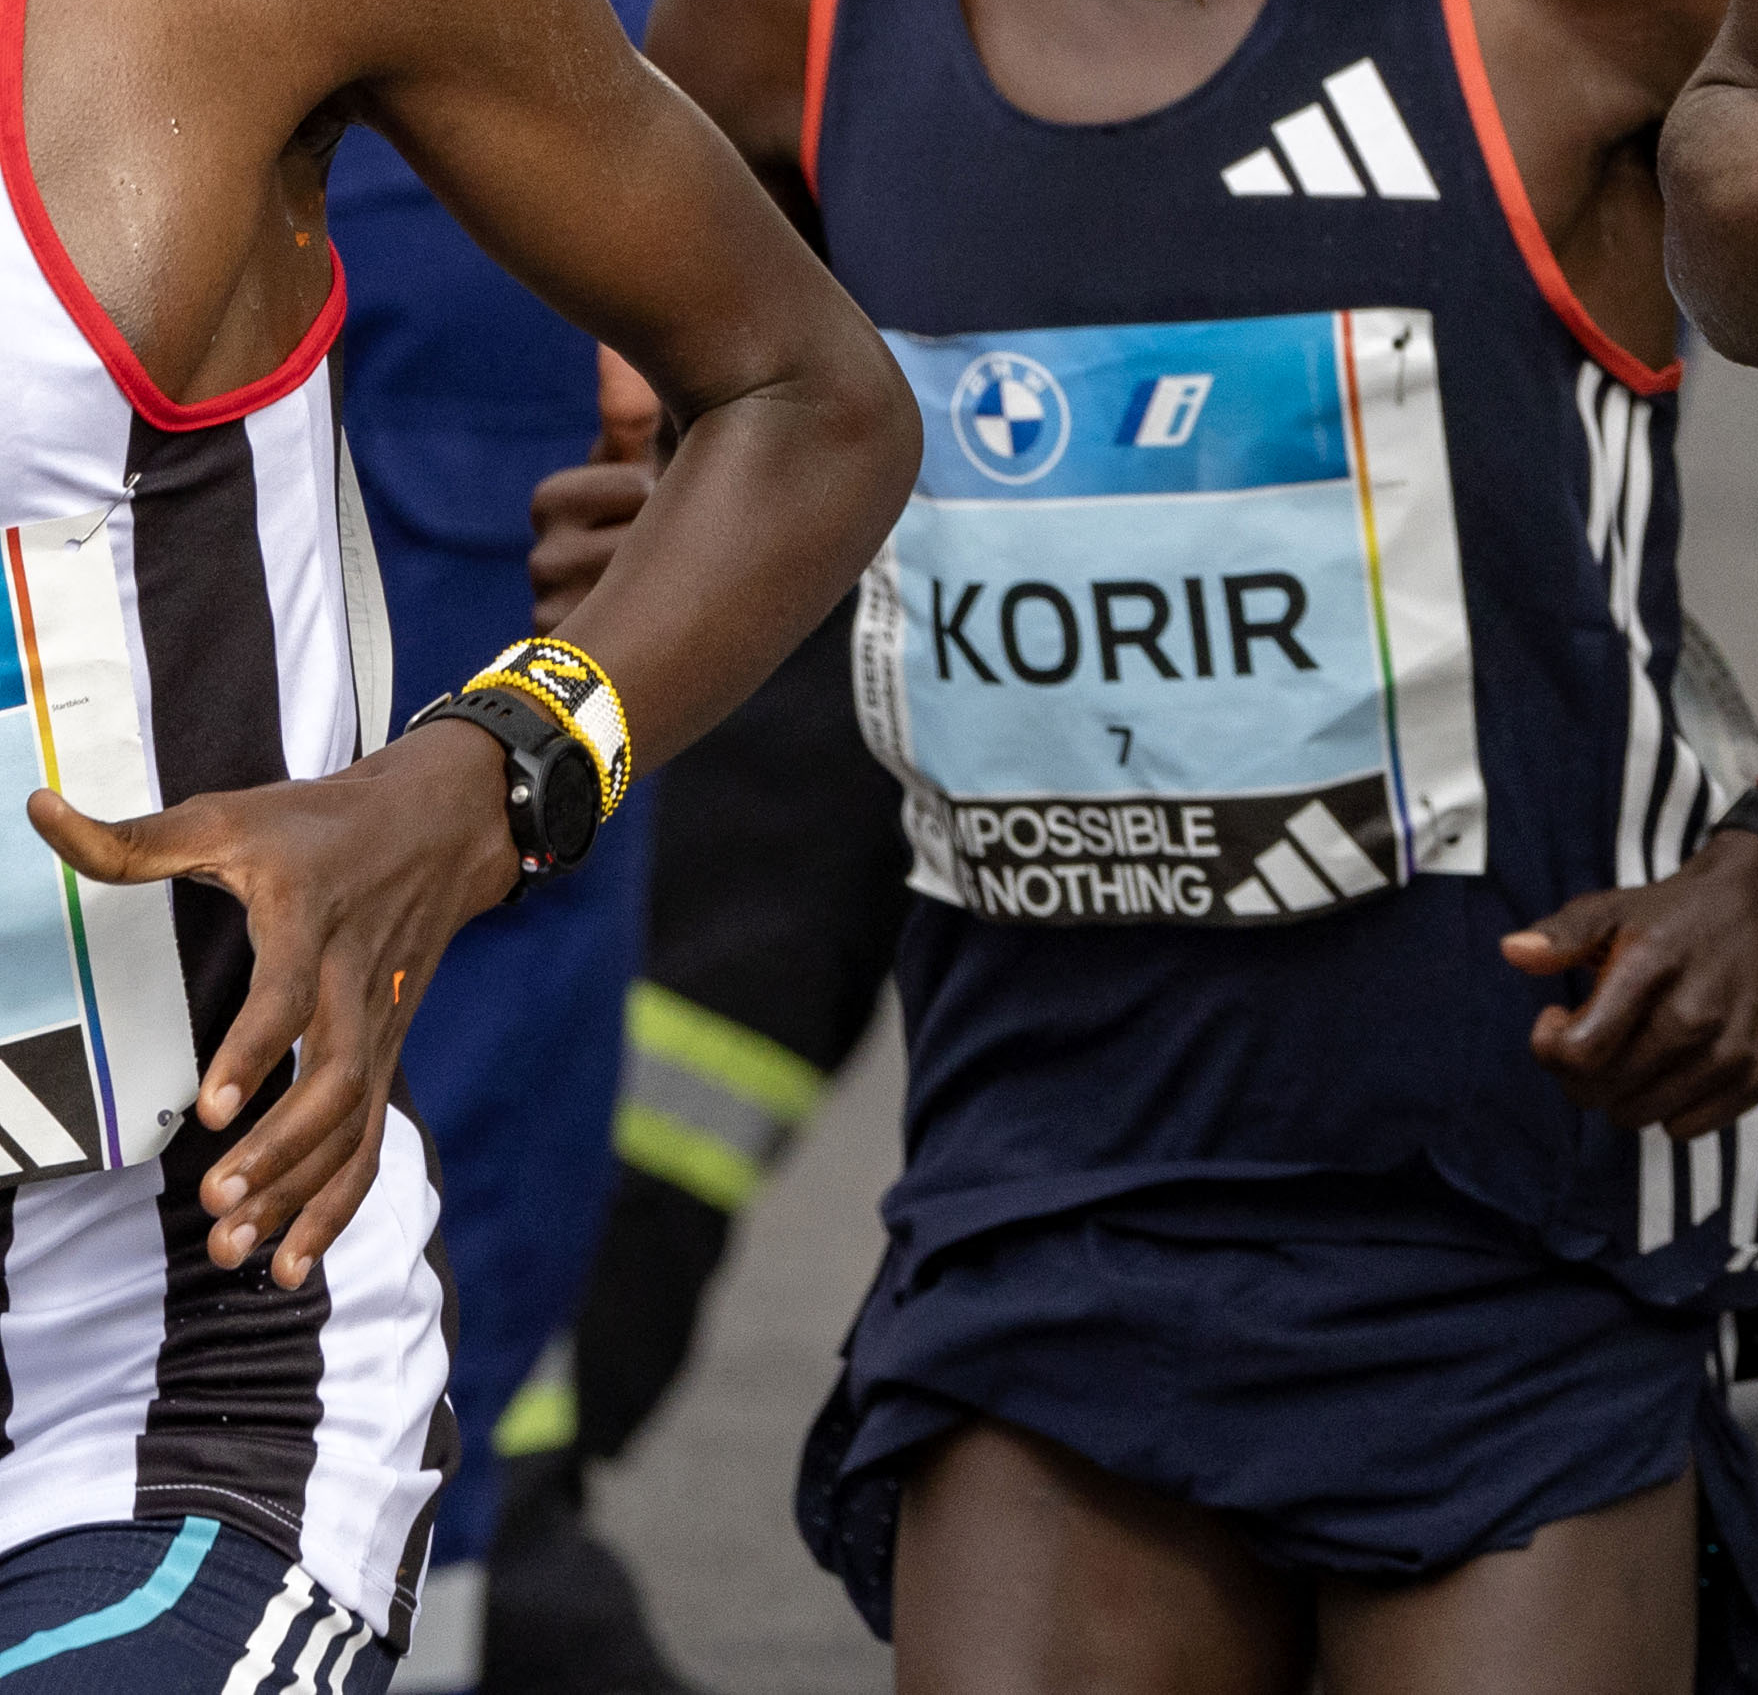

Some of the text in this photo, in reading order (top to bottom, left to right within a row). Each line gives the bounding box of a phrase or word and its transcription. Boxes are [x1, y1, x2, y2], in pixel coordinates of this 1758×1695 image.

[931, 570, 1320, 687] KORIR
[1107, 725, 1134, 766] 7
[977, 863, 1214, 918] NOTHING
